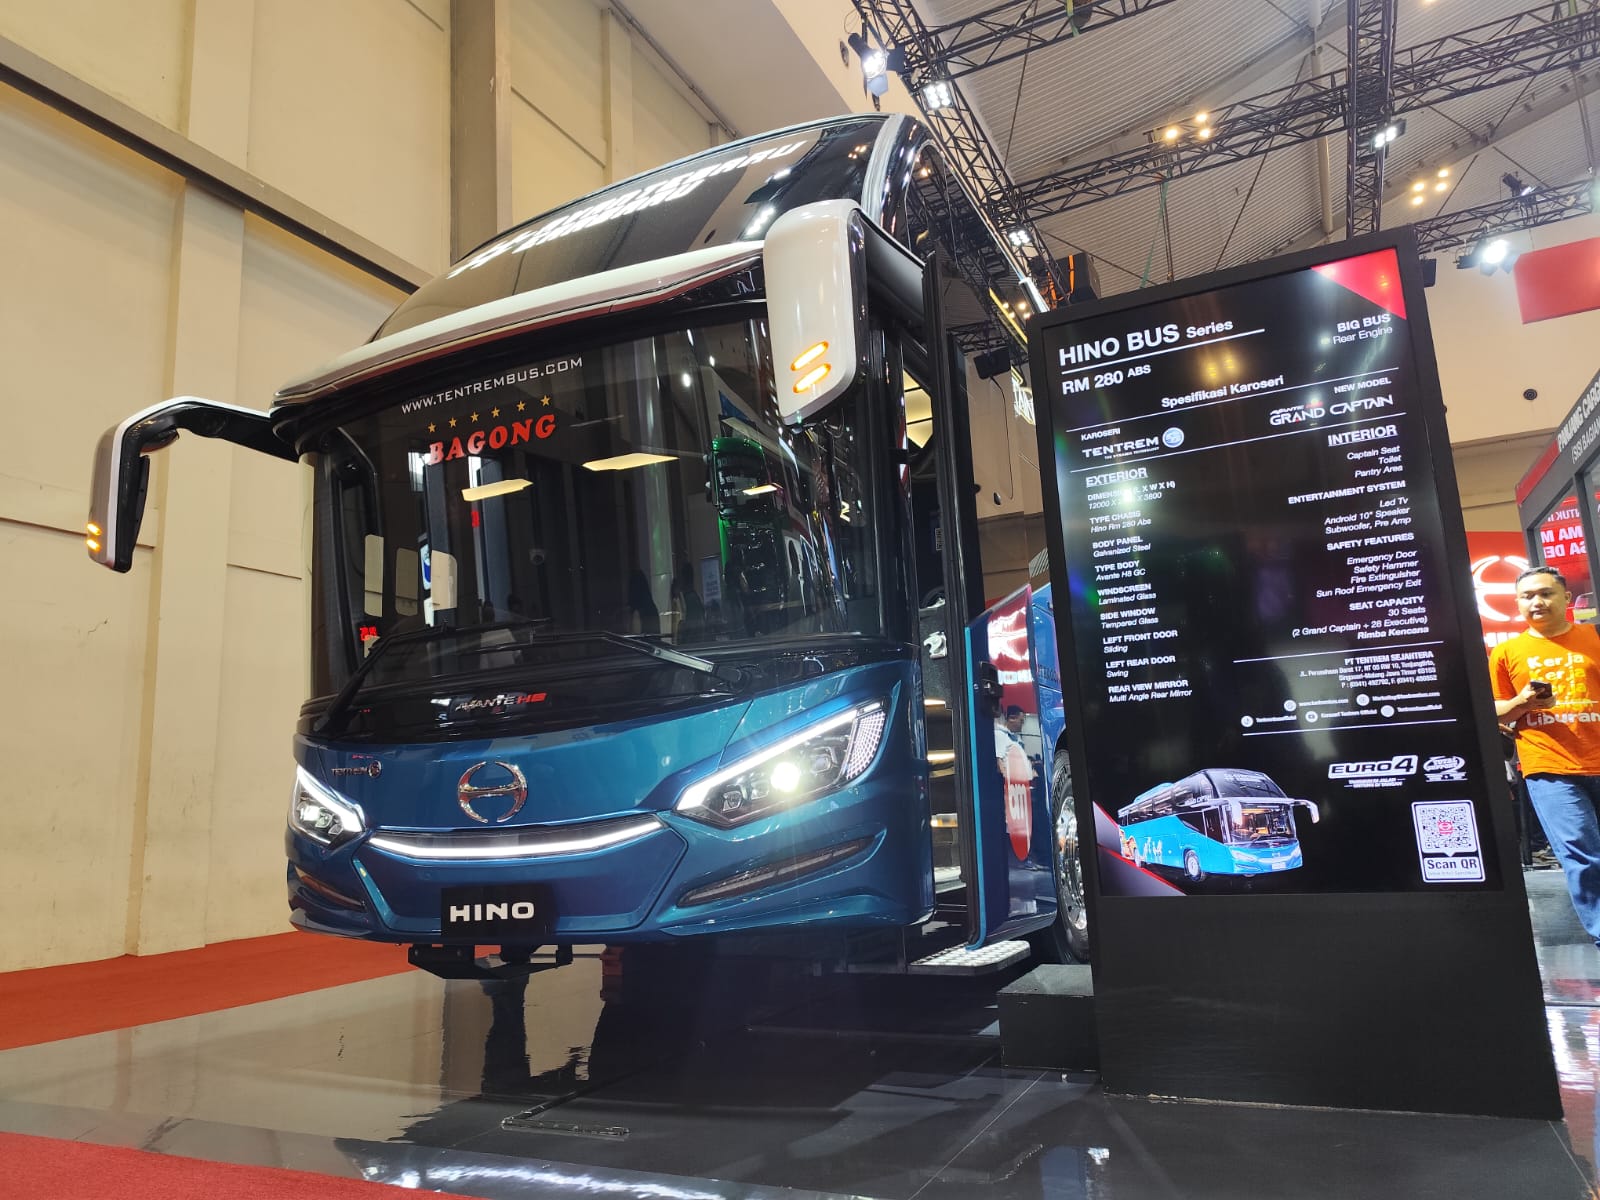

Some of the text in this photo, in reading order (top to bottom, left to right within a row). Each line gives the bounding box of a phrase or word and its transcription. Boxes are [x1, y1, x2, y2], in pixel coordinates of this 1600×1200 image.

[1337, 313, 1392, 332] BIG BUS
[1333, 325, 1393, 344] Rear Engine
[1059, 320, 1233, 366] HINO BUS Series
[402, 357, 582, 414] WWW.TENTREMBUS.COM
[1062, 364, 1151, 394] RM 280 ABS
[1334, 377, 1392, 394] NEW MODEL
[1161, 375, 1284, 408] Spesifikasi Karoseri
[1270, 394, 1394, 426] GRAND CAPTAIN
[427, 414, 556, 466] BAGONG
[1081, 428, 1120, 440] KAROSERI
[1328, 425, 1398, 445] INTERIOR
[1082, 436, 1159, 458] TENTREM
[1347, 446, 1400, 460] Captain Seat
[1378, 455, 1402, 464] Toilet
[1086, 468, 1148, 488] EXTERIOR
[1354, 465, 1403, 478] Pantry Area
[1142, 484, 1148, 492] X
[1150, 482, 1158, 490] W
[1159, 482, 1166, 490] X
[1288, 480, 1406, 504] ENTERTAINMENT SYSTEM
[1380, 496, 1408, 508] Led Tv
[1089, 516, 1110, 524] TYPE
[1324, 514, 1356, 525] Android
[1376, 507, 1410, 519] Speaker
[1090, 526, 1108, 534] Hino
[1136, 518, 1152, 526] Abs
[1326, 516, 1412, 534] Subwoofer, Pre Amp
[1092, 536, 1143, 550] BODY PANEL
[1326, 532, 1414, 551] SAFETY FEATURES
[1093, 543, 1152, 558] Galvanized Steel
[1347, 550, 1418, 565] Emergency Door
[1095, 560, 1140, 572] TYPE BODY
[1354, 560, 1419, 574] Safety Hammer
[1096, 573, 1120, 582] Avante
[1134, 568, 1146, 576] GC
[1351, 570, 1420, 584] Fire Extinguisher
[1097, 583, 1152, 596] WINDSCREEN
[1316, 579, 1422, 598] Sun Roof Emergency Exit
[1098, 592, 1156, 605] Laminated Glass
[1349, 596, 1424, 610] SEAT CAPACITY
[1100, 607, 1156, 620] SIDE WINDOW
[1388, 606, 1426, 616] 30 Seats
[1138, 616, 1158, 624] Glass
[1302, 626, 1328, 635] Grand
[1329, 622, 1361, 633] Captain
[1384, 616, 1428, 627] Executive)
[1103, 630, 1178, 644] LEFT FRONT DOOR
[1358, 627, 1429, 640] Rimba Kencana
[1104, 645, 1128, 654] Sliding
[1106, 656, 1176, 669] LEFT REAR DOOR
[1528, 652, 1584, 669] Kerja
[1106, 670, 1128, 678] Swing
[1529, 666, 1586, 682] Kerja
[1108, 680, 1188, 693] REAR VIEW MIRROR
[1128, 692, 1149, 702] Angle
[1526, 712, 1600, 726] Liburan
[1332, 758, 1414, 774] EURO4
[1428, 858, 1478, 870] Scan QR
[450, 902, 534, 922] HINO
